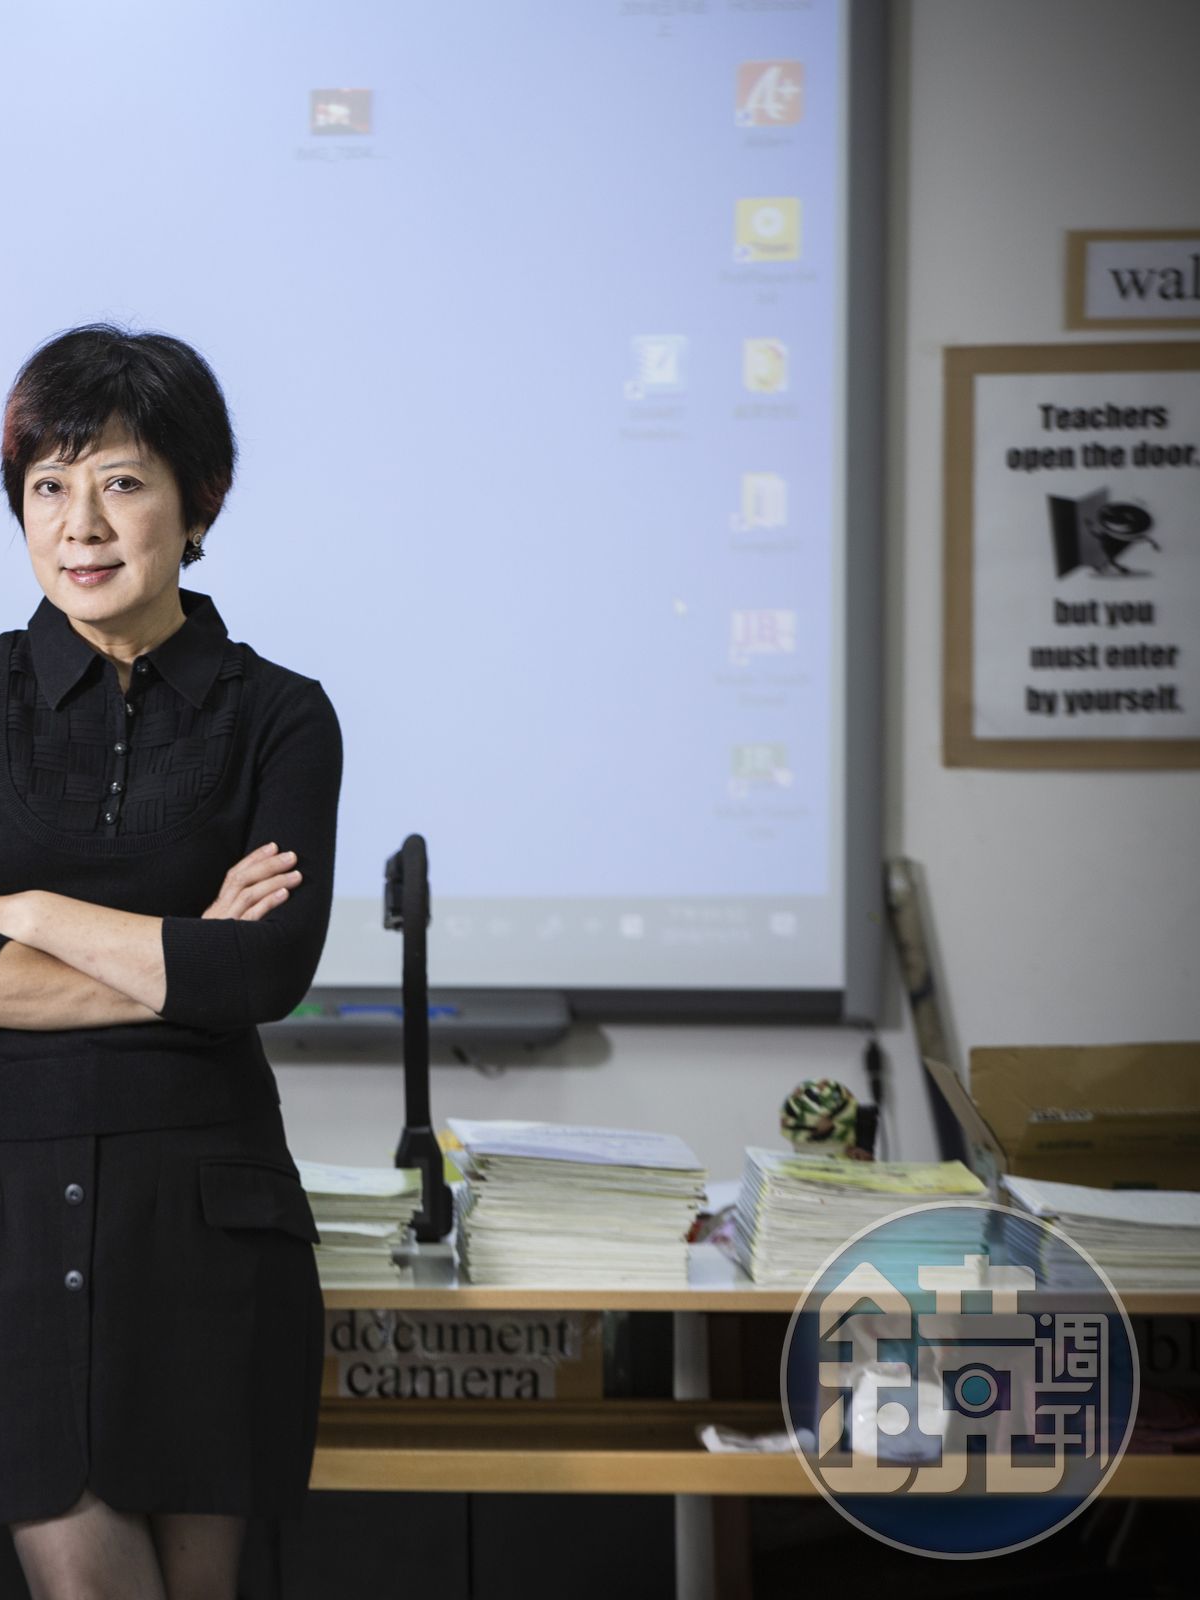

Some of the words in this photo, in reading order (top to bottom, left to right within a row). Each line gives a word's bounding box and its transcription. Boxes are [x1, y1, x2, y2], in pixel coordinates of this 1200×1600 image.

[1040, 402, 1169, 432] Teachers
[1006, 447, 1075, 473] open
[1081, 443, 1126, 470] the
[1053, 598, 1100, 627] but
[1104, 600, 1155, 629] you
[1030, 646, 1100, 670] must
[1105, 644, 1180, 668] enter
[1026, 686, 1058, 716] by
[1065, 684, 1186, 716] yourself.
[345, 1362, 542, 1399] camera
